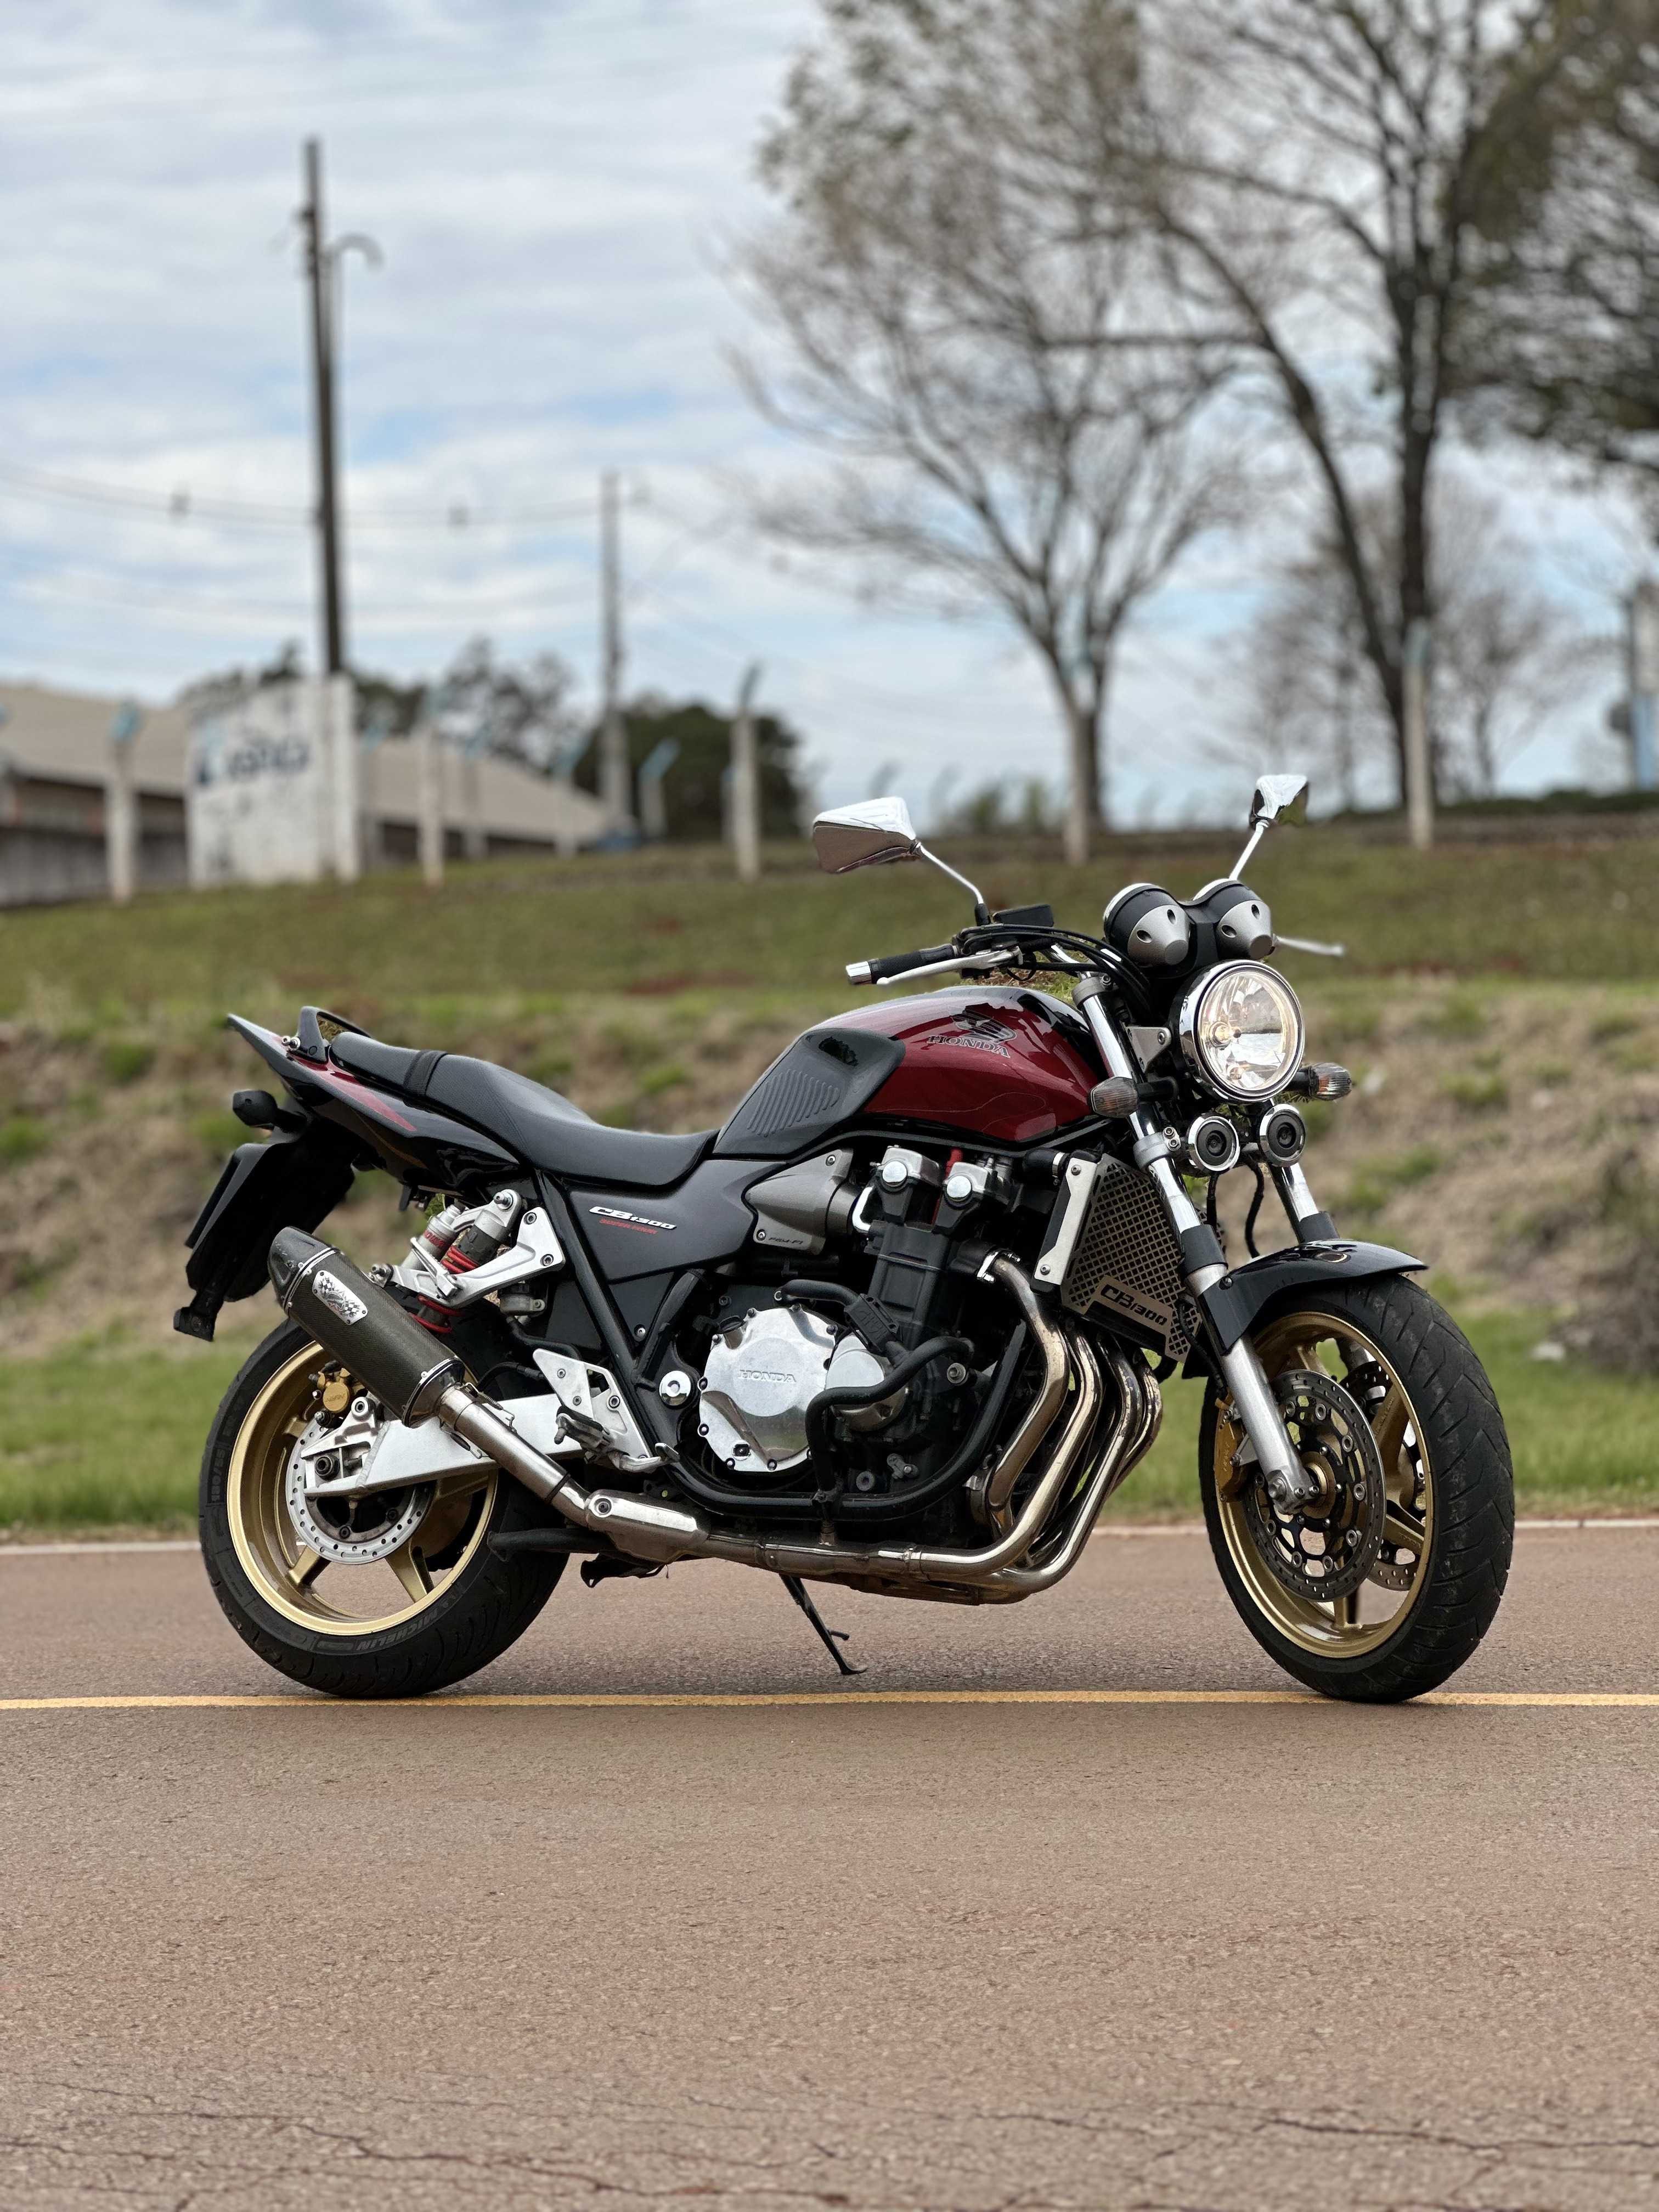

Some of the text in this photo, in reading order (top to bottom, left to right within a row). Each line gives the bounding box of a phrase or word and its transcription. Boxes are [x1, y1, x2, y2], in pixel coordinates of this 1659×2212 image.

[928, 1036, 1011, 1058] HONDA
[589, 1206, 676, 1229] CB1300
[1101, 1284, 1167, 1326] CB1300
[738, 1369, 796, 1383] HONDA
[356, 1609, 438, 1651] MICHELIN
